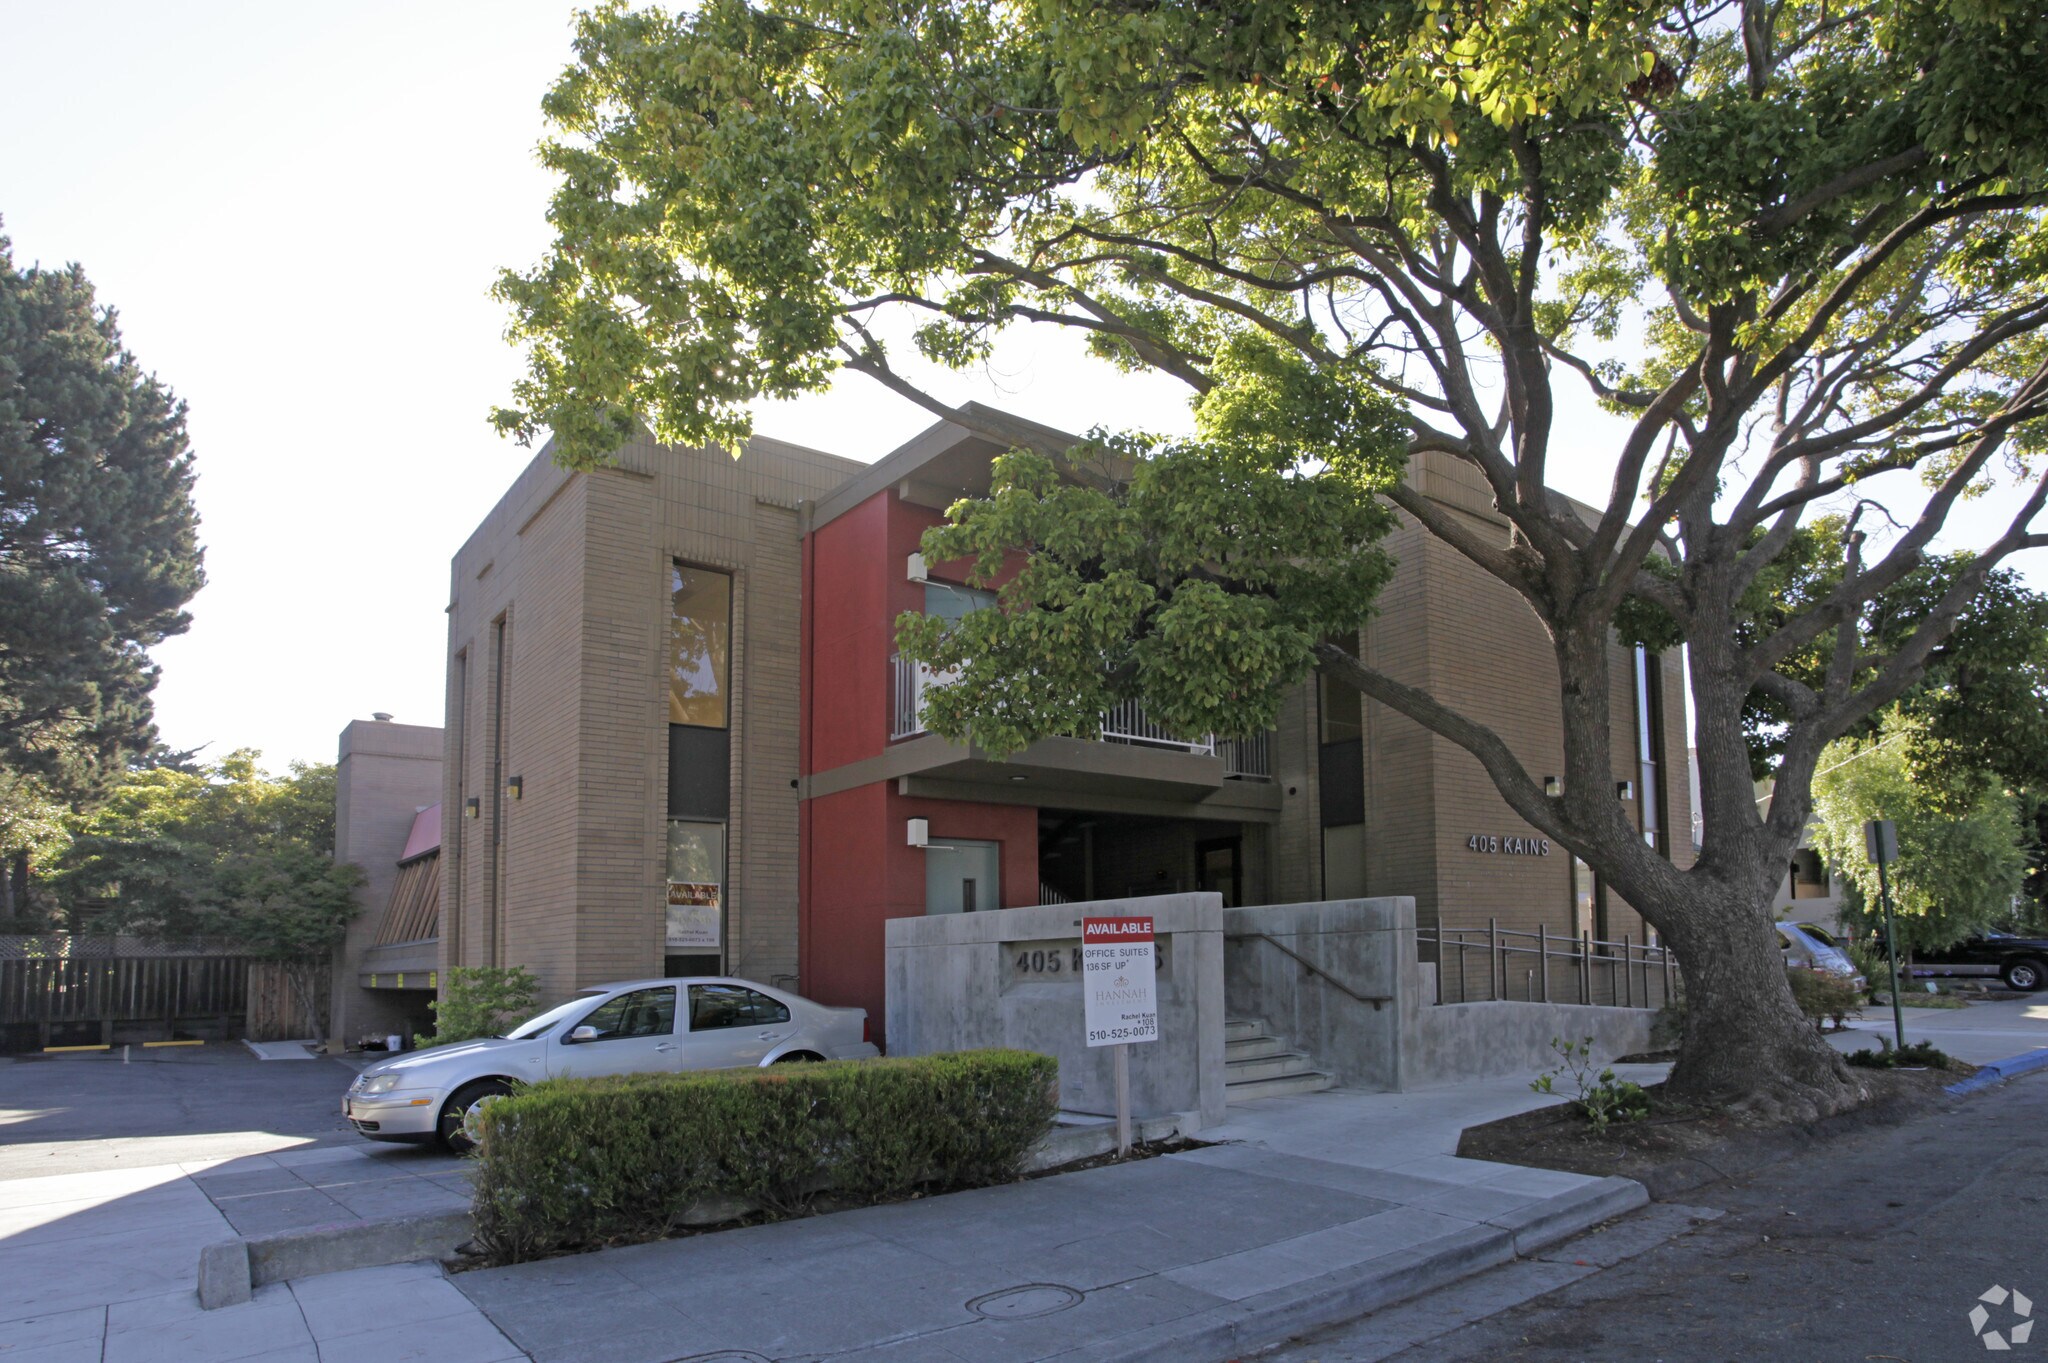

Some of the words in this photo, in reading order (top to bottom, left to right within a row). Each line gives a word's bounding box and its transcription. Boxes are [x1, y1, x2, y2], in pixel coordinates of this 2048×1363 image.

[1468, 835, 1497, 853] 405
[1503, 837, 1550, 856] KAINS
[670, 891, 717, 899] AVAILABLE
[1086, 922, 1152, 935] AVAILABLE
[1084, 949, 1116, 958] OFFICE
[1119, 947, 1149, 957] SUITES
[1016, 950, 1061, 973] 405
[1095, 987, 1147, 1001] HANNAH
[1121, 1012, 1141, 1020] Rachel
[1142, 1017, 1155, 1026] 108
[1089, 1025, 1156, 1041] 510-525-0073
